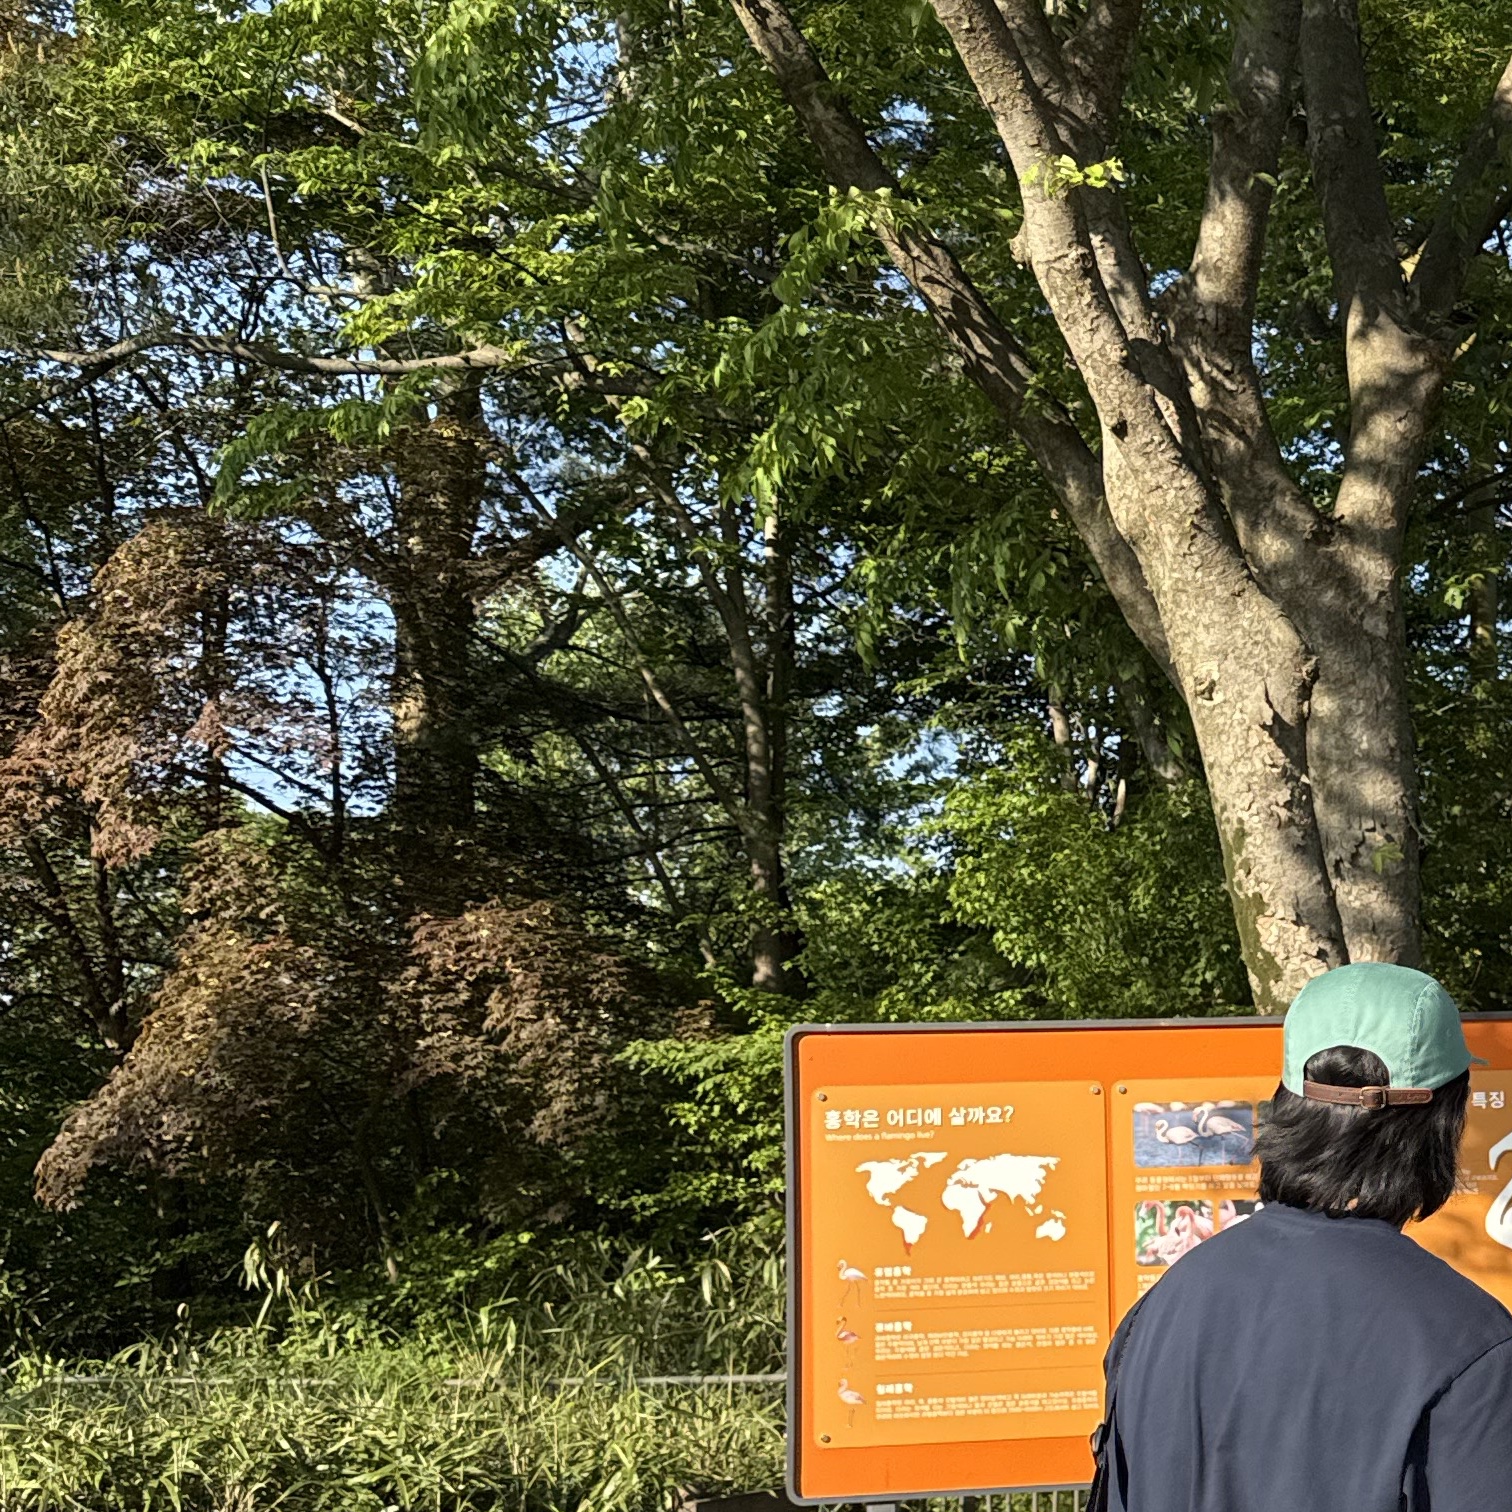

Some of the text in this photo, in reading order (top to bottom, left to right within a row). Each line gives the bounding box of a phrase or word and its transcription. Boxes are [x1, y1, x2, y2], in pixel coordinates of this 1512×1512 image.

[1472, 1091, 1505, 1109] 특징
[823, 1105, 1015, 1130] 홍학은 어디에 살까요?
[825, 1133, 852, 1142] Where
[853, 1133, 873, 1142] does
[881, 1131, 915, 1141] flamingo
[916, 1130, 935, 1140] live?
